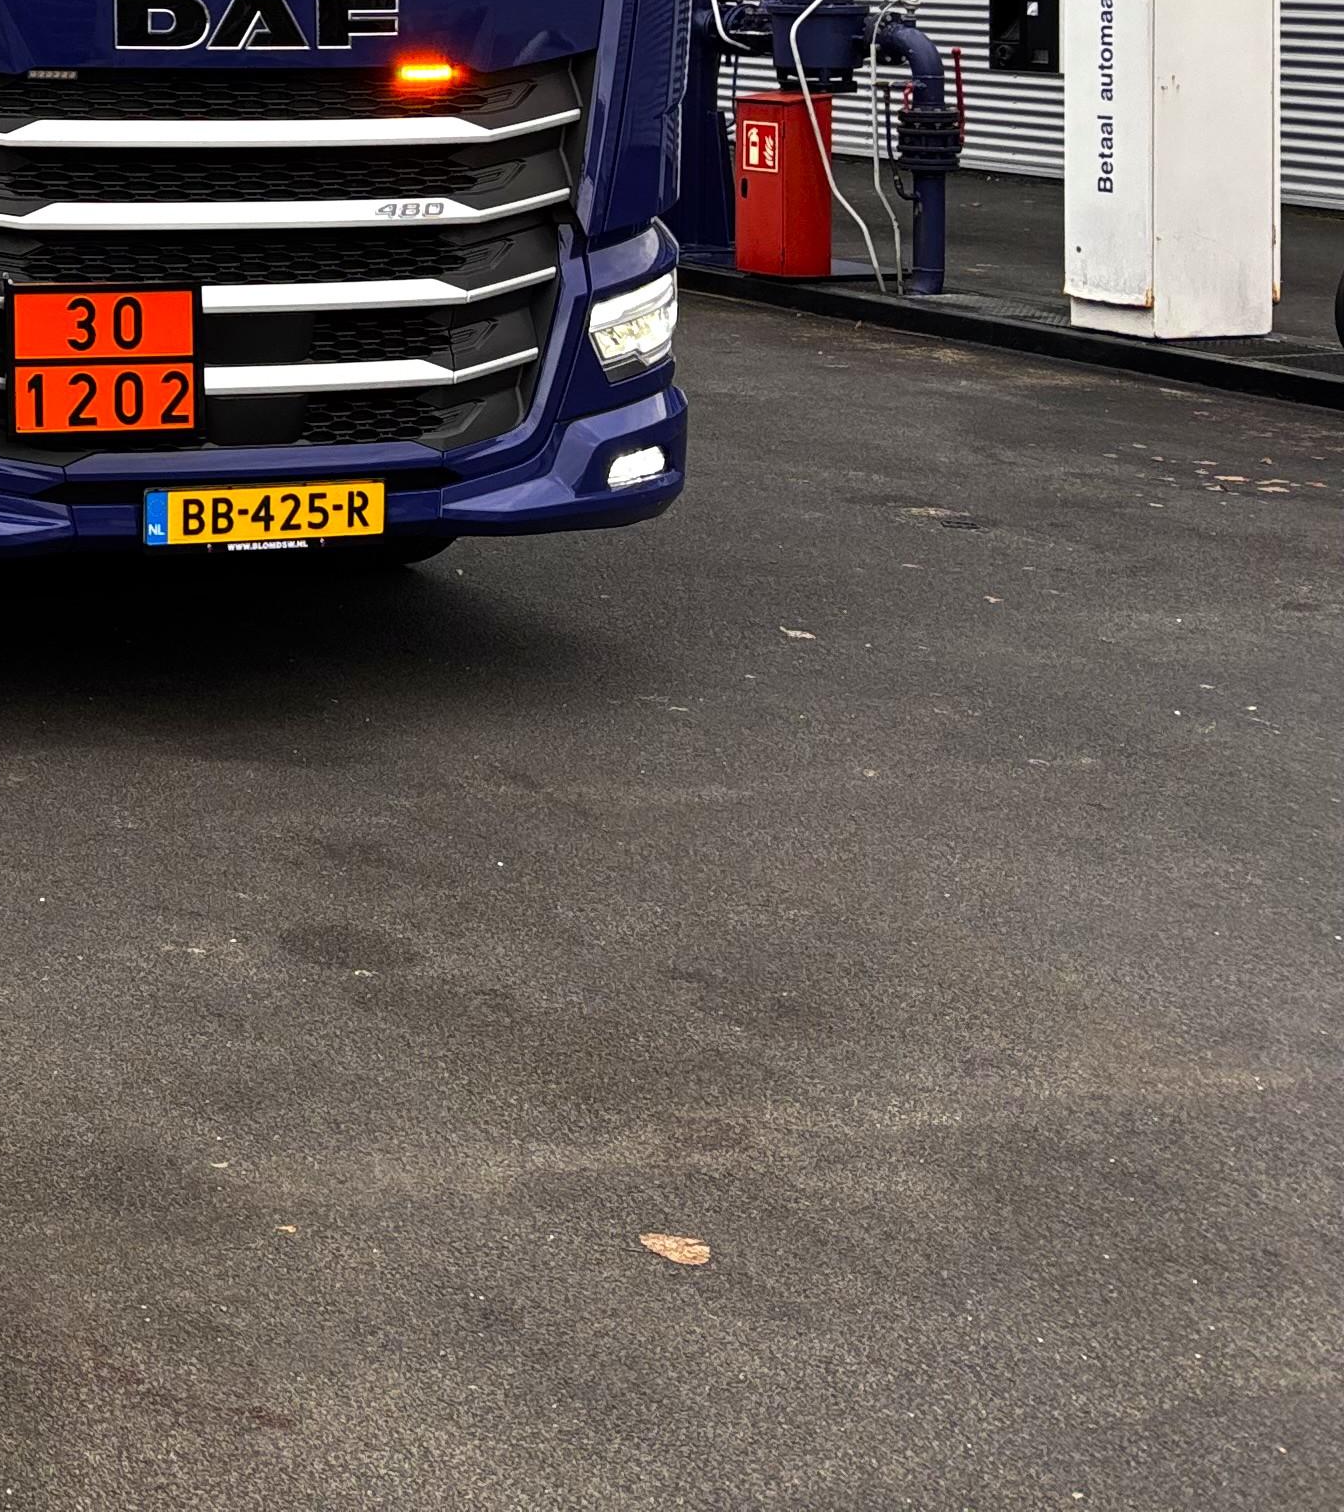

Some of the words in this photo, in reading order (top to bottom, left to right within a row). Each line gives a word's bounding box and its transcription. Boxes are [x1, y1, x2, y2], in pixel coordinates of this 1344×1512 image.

[1097, 115, 1114, 193] Betaal
[375, 203, 444, 219] 480
[66, 297, 144, 351] 30
[27, 371, 191, 428] 1202
[148, 524, 165, 536] NL
[182, 491, 370, 536] BB-425-R
